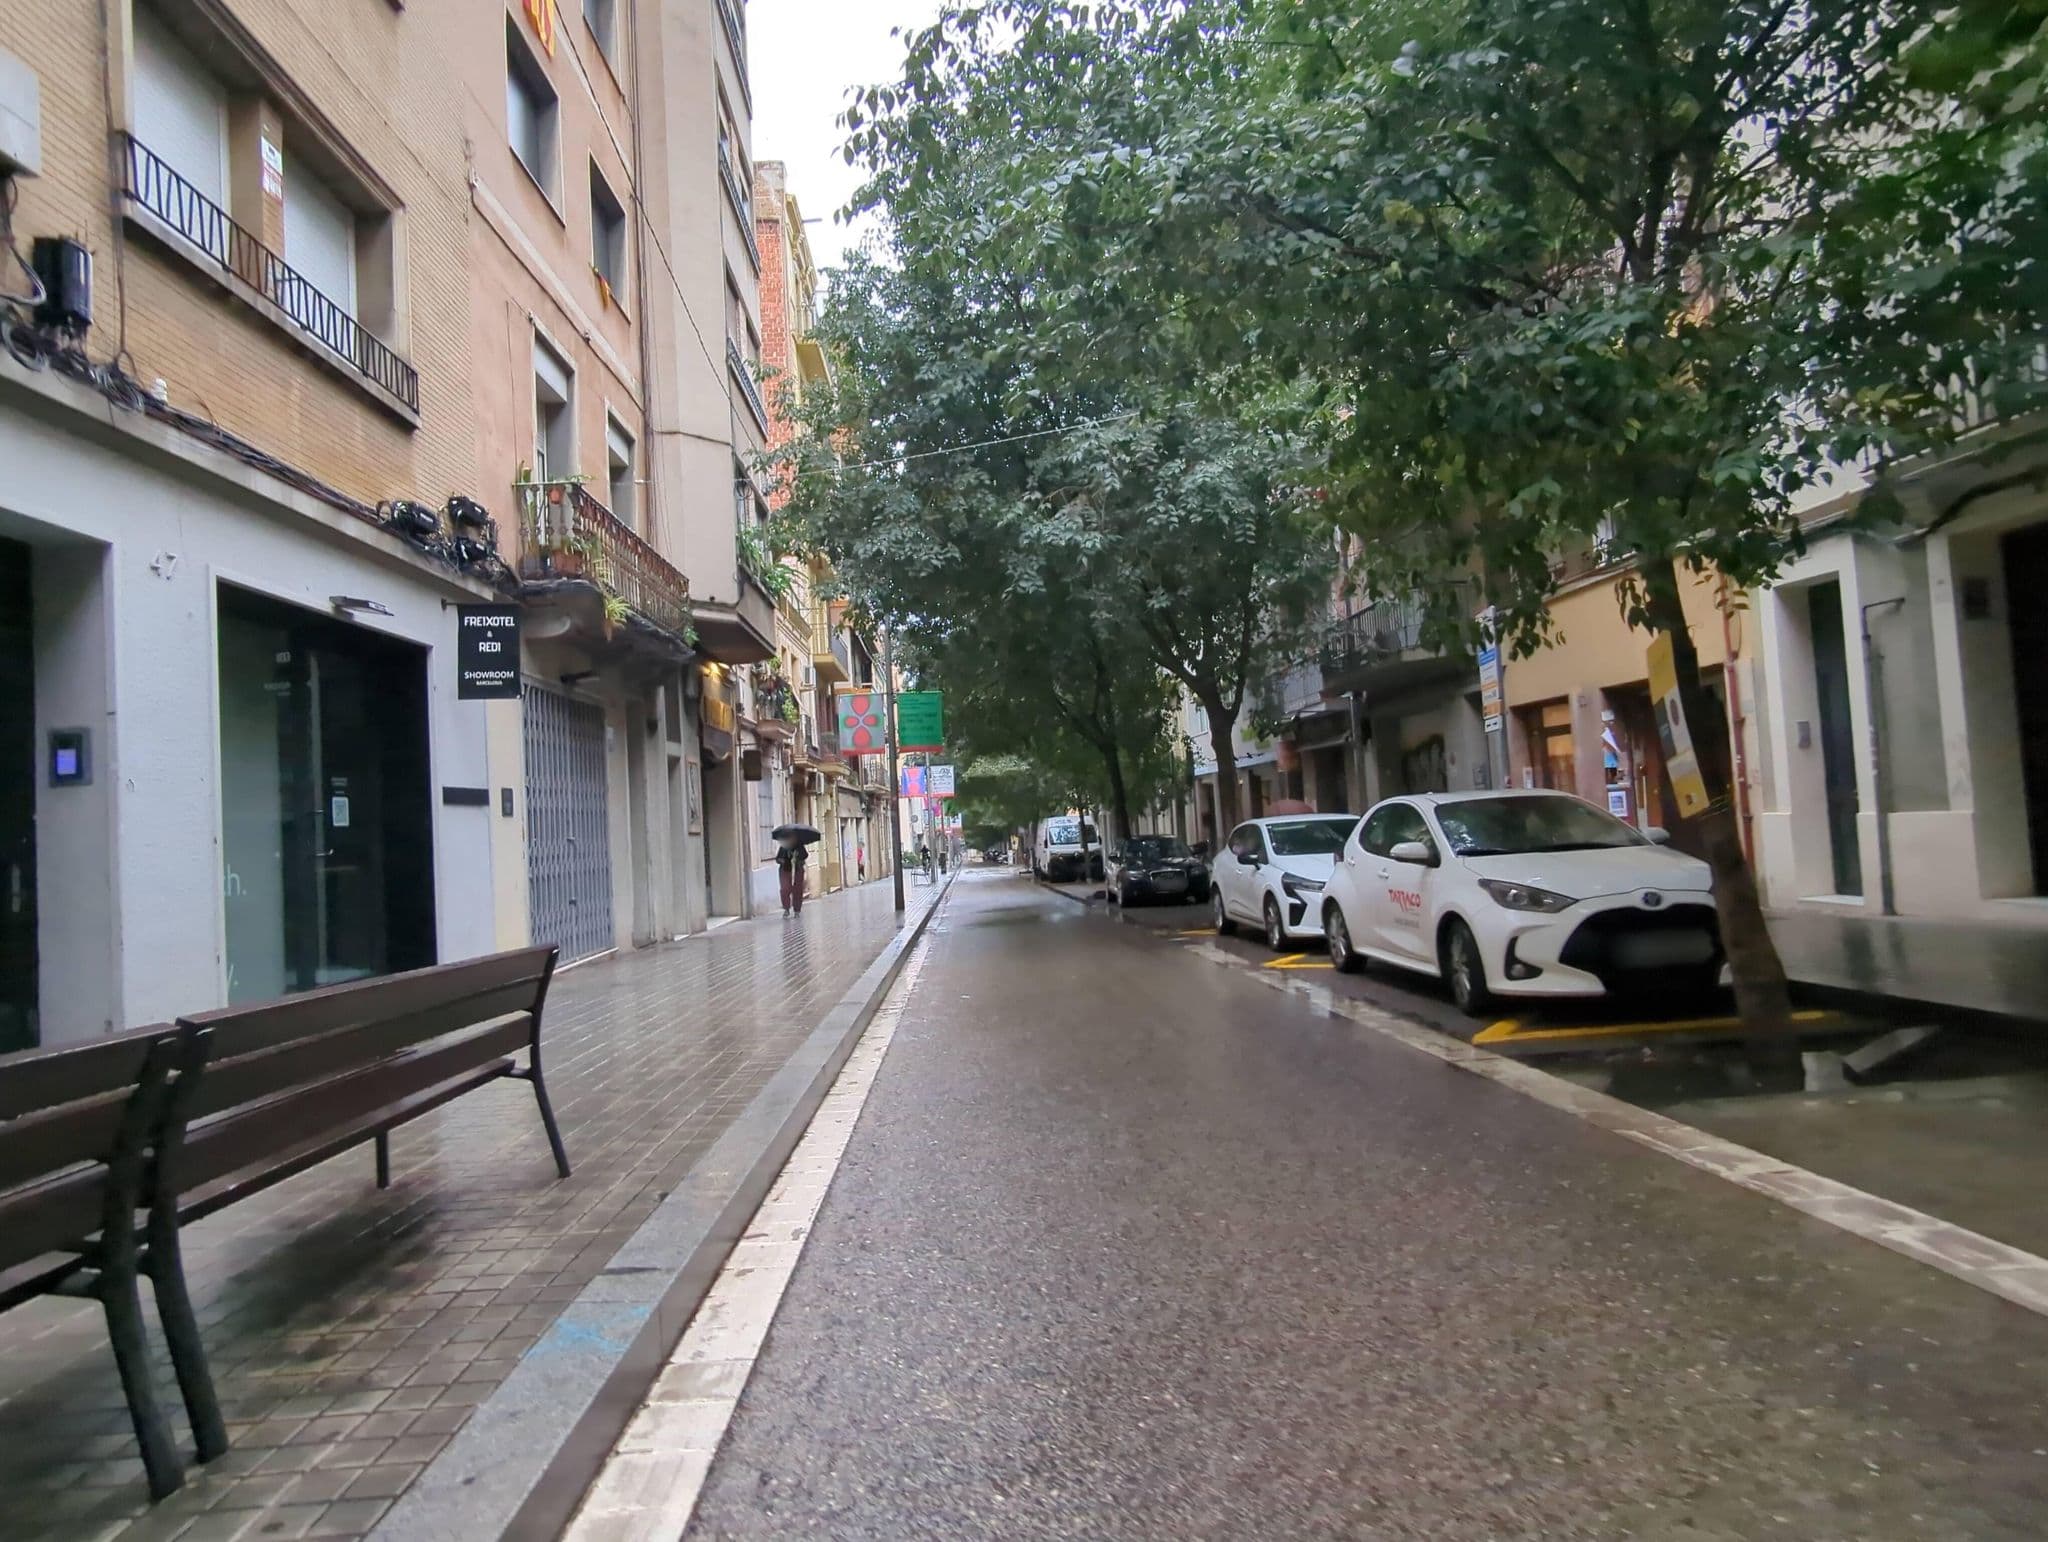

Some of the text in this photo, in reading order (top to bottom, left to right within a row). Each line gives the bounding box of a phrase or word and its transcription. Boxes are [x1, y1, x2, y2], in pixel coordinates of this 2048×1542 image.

[464, 616, 516, 627] FREIXOTEL
[478, 641, 502, 653] REDI
[464, 671, 514, 680] SHOWROOM
